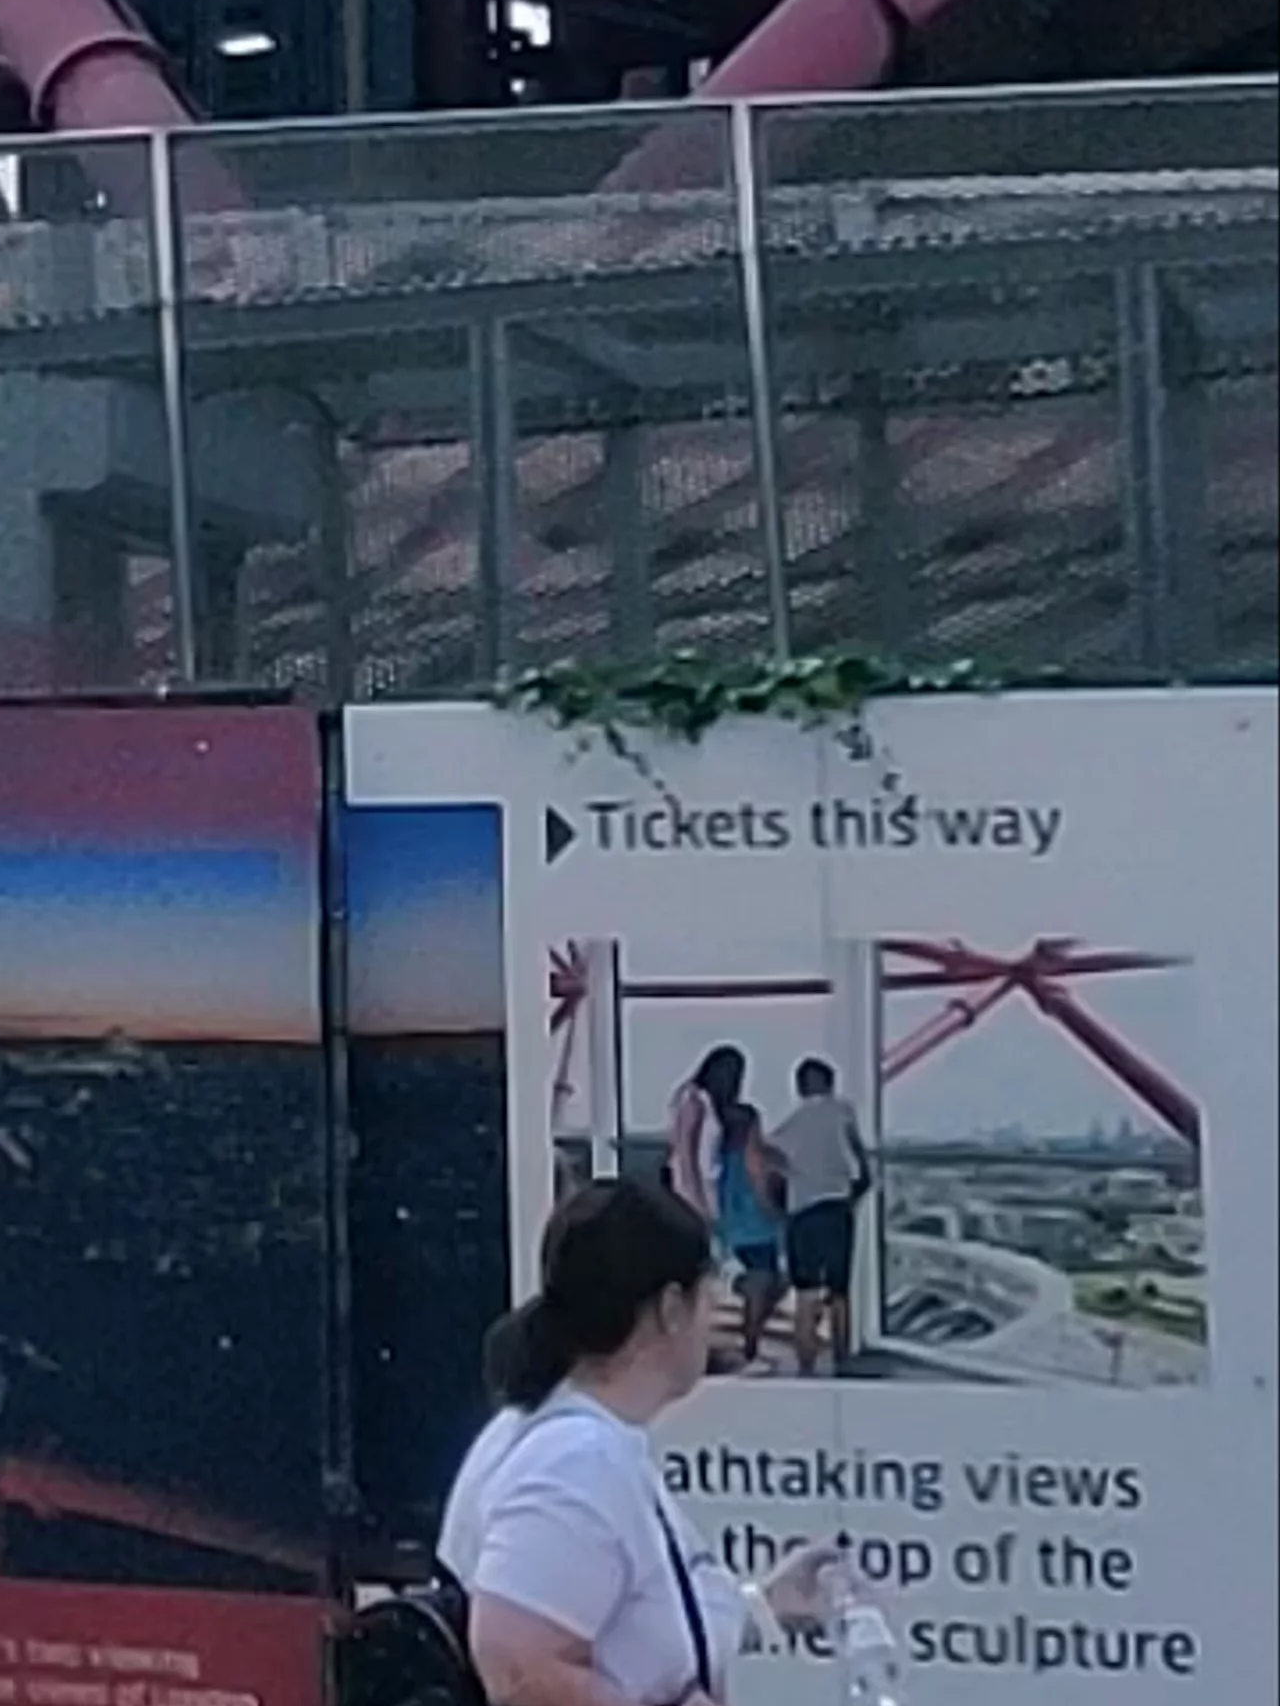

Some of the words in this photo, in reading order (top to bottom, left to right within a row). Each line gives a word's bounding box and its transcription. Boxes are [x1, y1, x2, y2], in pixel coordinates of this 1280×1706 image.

[586, 798, 791, 851] Tickets
[810, 796, 920, 850] this
[937, 806, 1062, 856] way
[662, 1447, 944, 1512] athtaking
[965, 1454, 1142, 1510] views
[722, 1522, 807, 1576] th
[954, 1532, 1019, 1586] of
[1038, 1537, 1133, 1591] the
[909, 1615, 1196, 1674] sculpture
